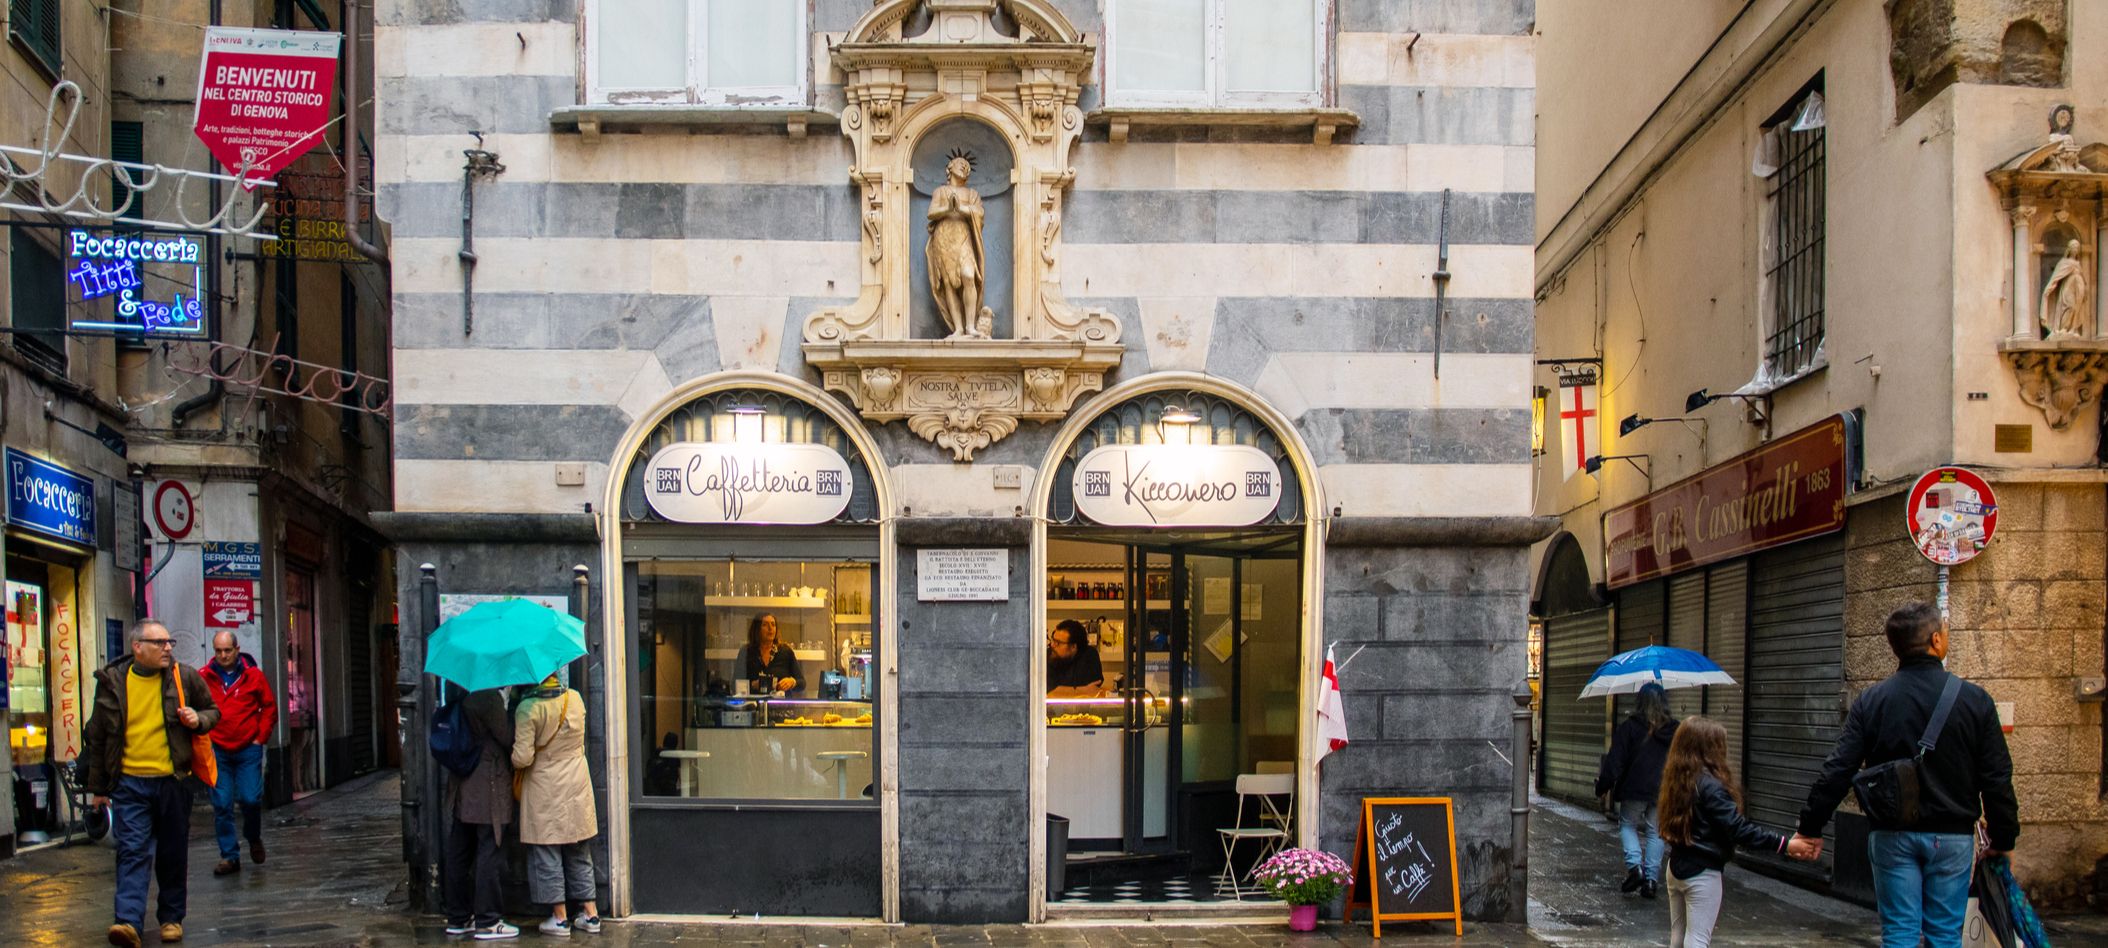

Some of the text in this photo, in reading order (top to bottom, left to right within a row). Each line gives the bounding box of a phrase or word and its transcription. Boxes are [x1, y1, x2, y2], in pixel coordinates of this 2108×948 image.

[216, 65, 316, 90] BENVENUTI
[204, 87, 323, 107] NEL CENTRO STORICO
[231, 104, 288, 119] DI GENOVA
[203, 124, 220, 134] Arte,
[221, 126, 252, 136] tradizioni,
[253, 128, 285, 138] botteghe
[228, 136, 251, 146] palazzi
[252, 137, 289, 148] Patrimonio
[70, 231, 199, 261] Focacceria
[262, 239, 368, 260] ARTIGIANAL
[70, 259, 141, 296] Titti
[118, 289, 202, 329] & Fede
[920, 382, 1008, 392] NOSTRA TVTELA
[947, 391, 979, 401] SALVE
[657, 469, 681, 481] BRN
[817, 471, 841, 483] BRN
[1086, 473, 1110, 484] BRN
[1246, 473, 1270, 484] BRN
[12, 460, 92, 520] Focacceria
[686, 454, 813, 521] Caffetteria
[1696, 460, 1799, 544] Cassinelli
[1805, 468, 1831, 495] 1863
[204, 553, 260, 563] SERRAMENTI
[209, 592, 219, 600] da
[57, 603, 78, 757] FOCACCERIA
[1374, 811, 1403, 839] Giusto
[1377, 831, 1413, 861] il tempo
[1384, 865, 1397, 886] per
